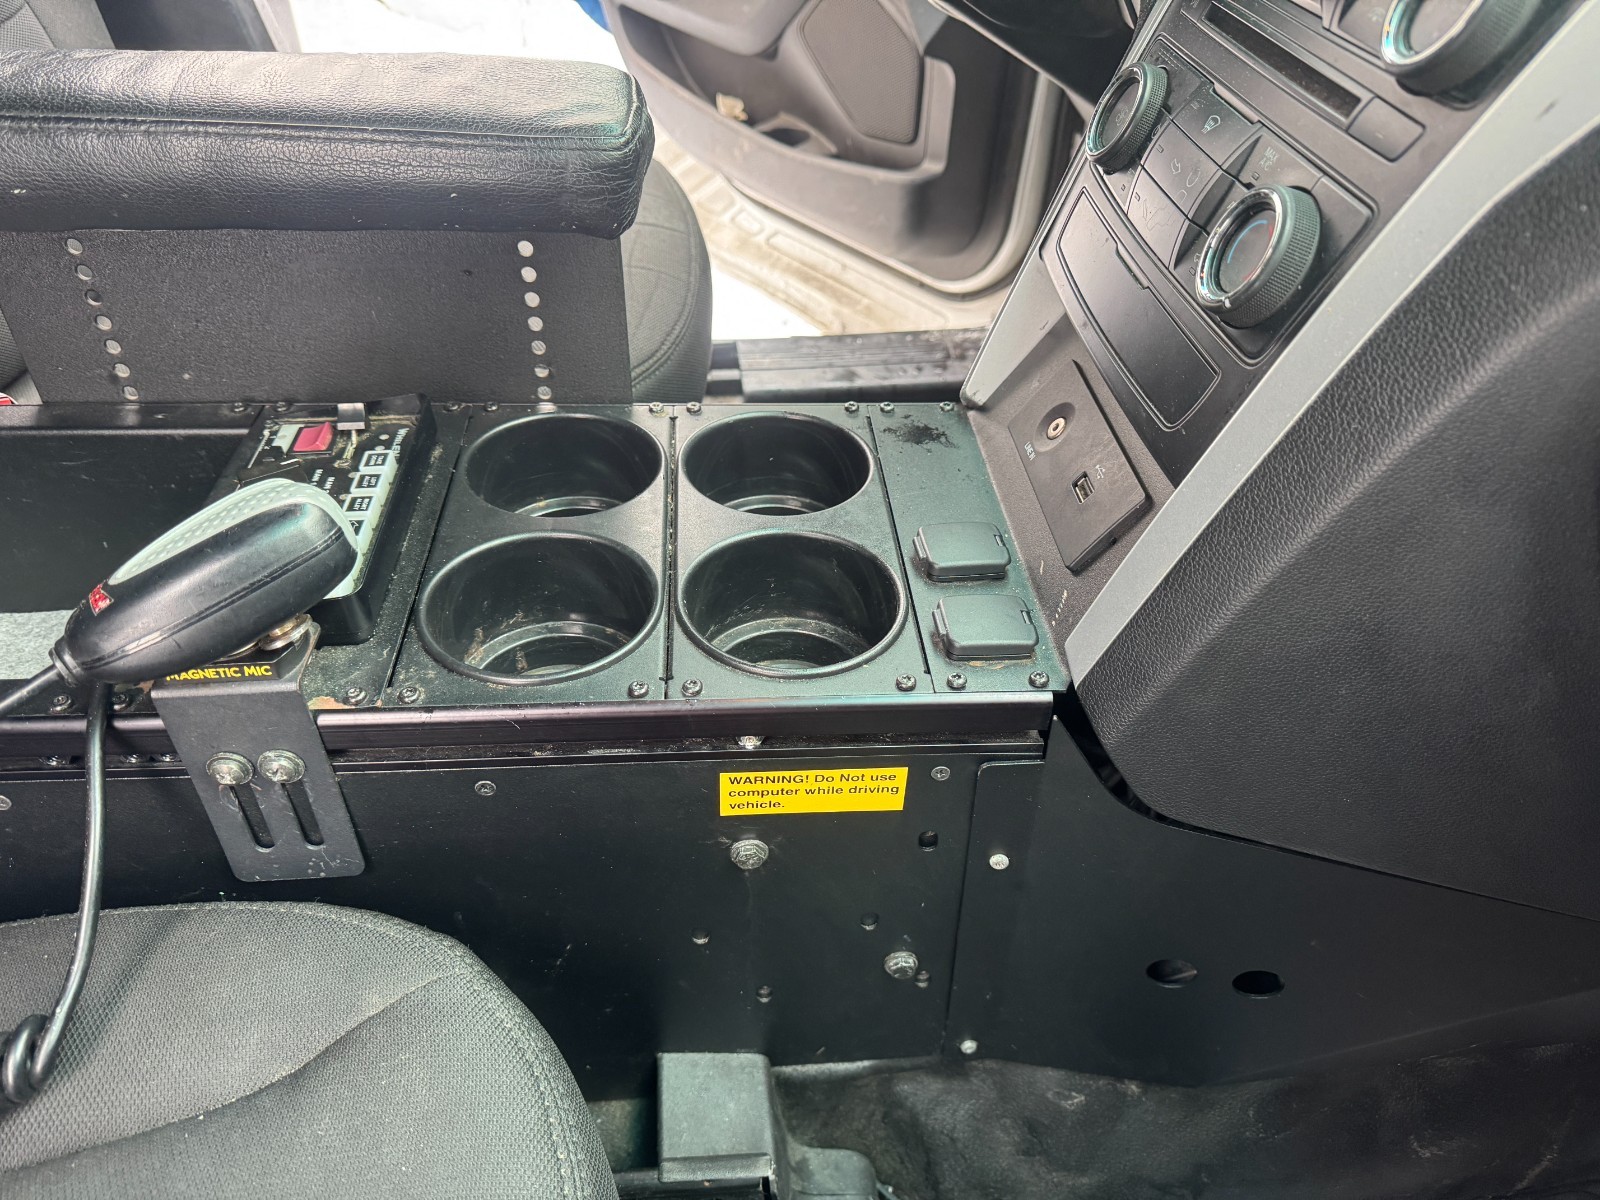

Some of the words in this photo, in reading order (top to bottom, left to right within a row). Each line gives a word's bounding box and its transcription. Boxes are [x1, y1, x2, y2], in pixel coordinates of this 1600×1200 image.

[243, 665, 273, 677] MIC
[728, 774, 810, 785] WARNING!
[814, 774, 835, 783] Do
[839, 773, 866, 782] Not
[870, 773, 897, 782] use
[728, 786, 800, 798] computer
[804, 786, 844, 795] while
[848, 784, 900, 795] driving
[728, 800, 785, 810] vehicle.
